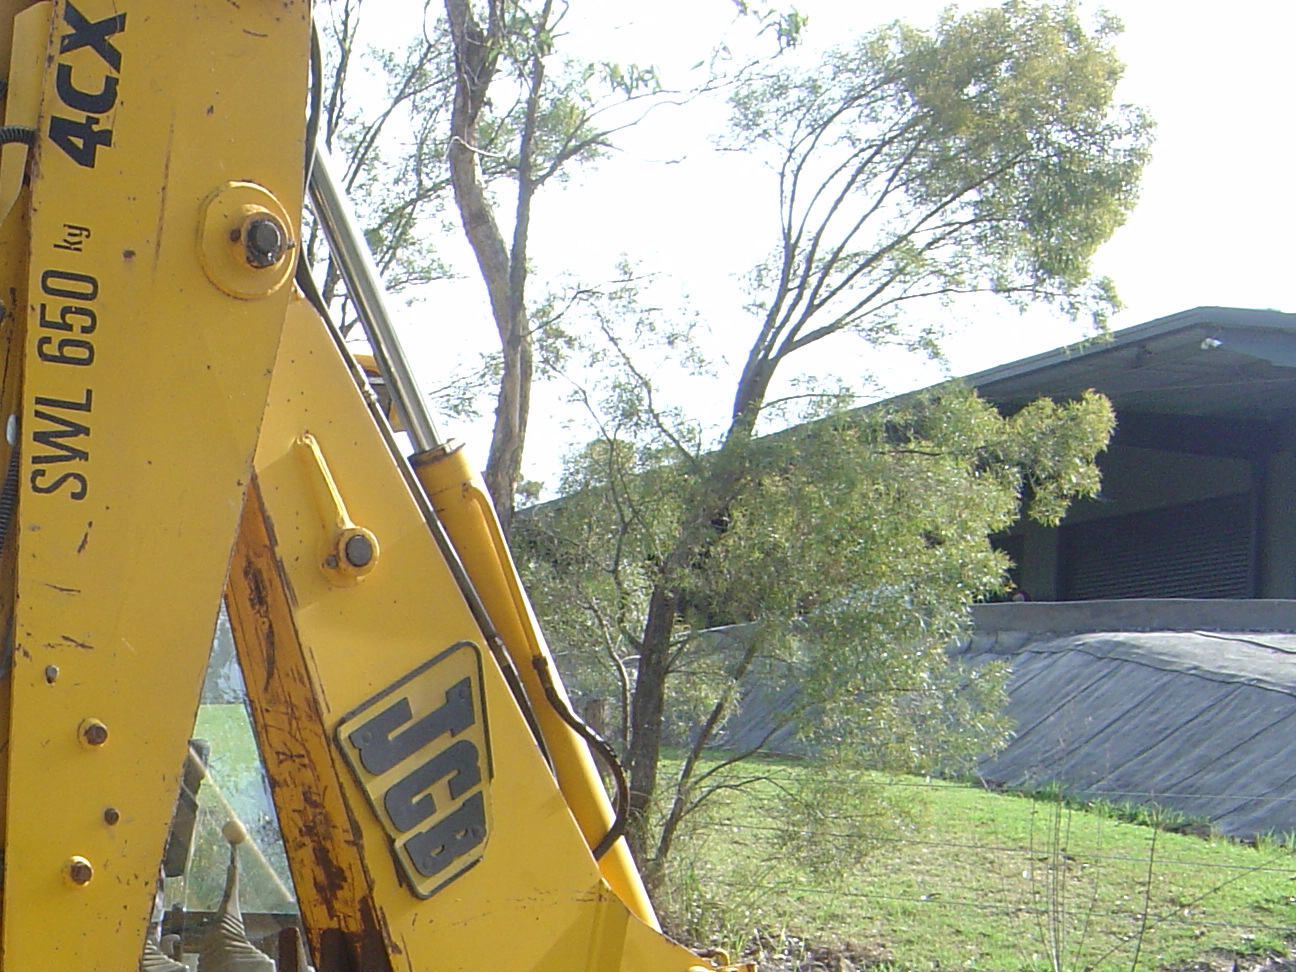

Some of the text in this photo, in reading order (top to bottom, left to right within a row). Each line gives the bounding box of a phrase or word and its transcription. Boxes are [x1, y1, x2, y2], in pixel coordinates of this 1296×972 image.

[49, 0, 127, 168] 4CX
[30, 223, 99, 501] SWL 650 kg
[348, 676, 487, 877] JCB
